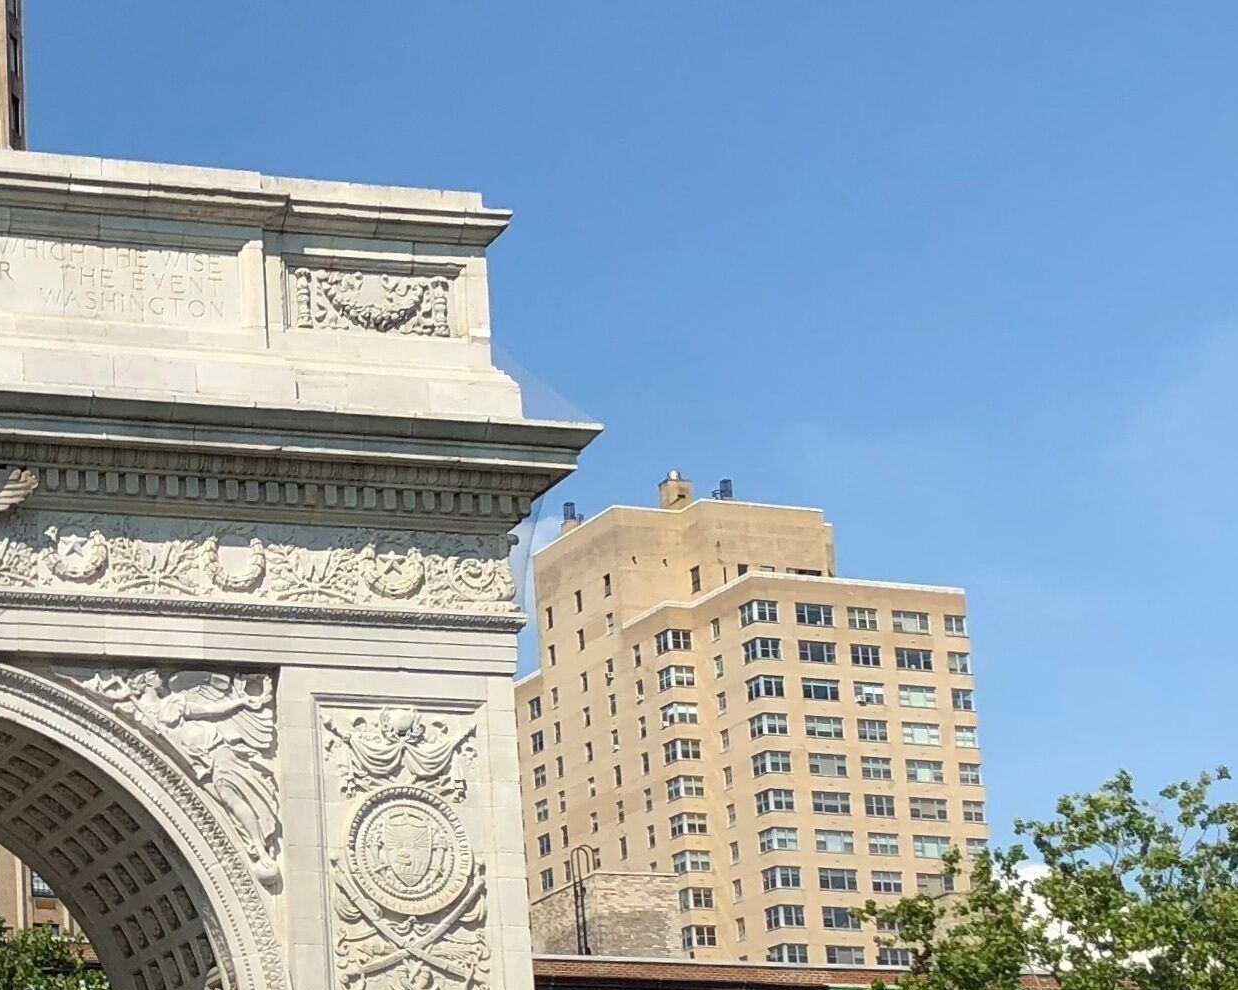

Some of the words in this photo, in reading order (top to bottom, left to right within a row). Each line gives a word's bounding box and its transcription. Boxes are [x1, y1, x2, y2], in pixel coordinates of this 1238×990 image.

[159, 250, 222, 274] WISE
[59, 264, 114, 289] THE
[132, 270, 223, 297] EVENT
[39, 287, 224, 318] WASHINGTON
